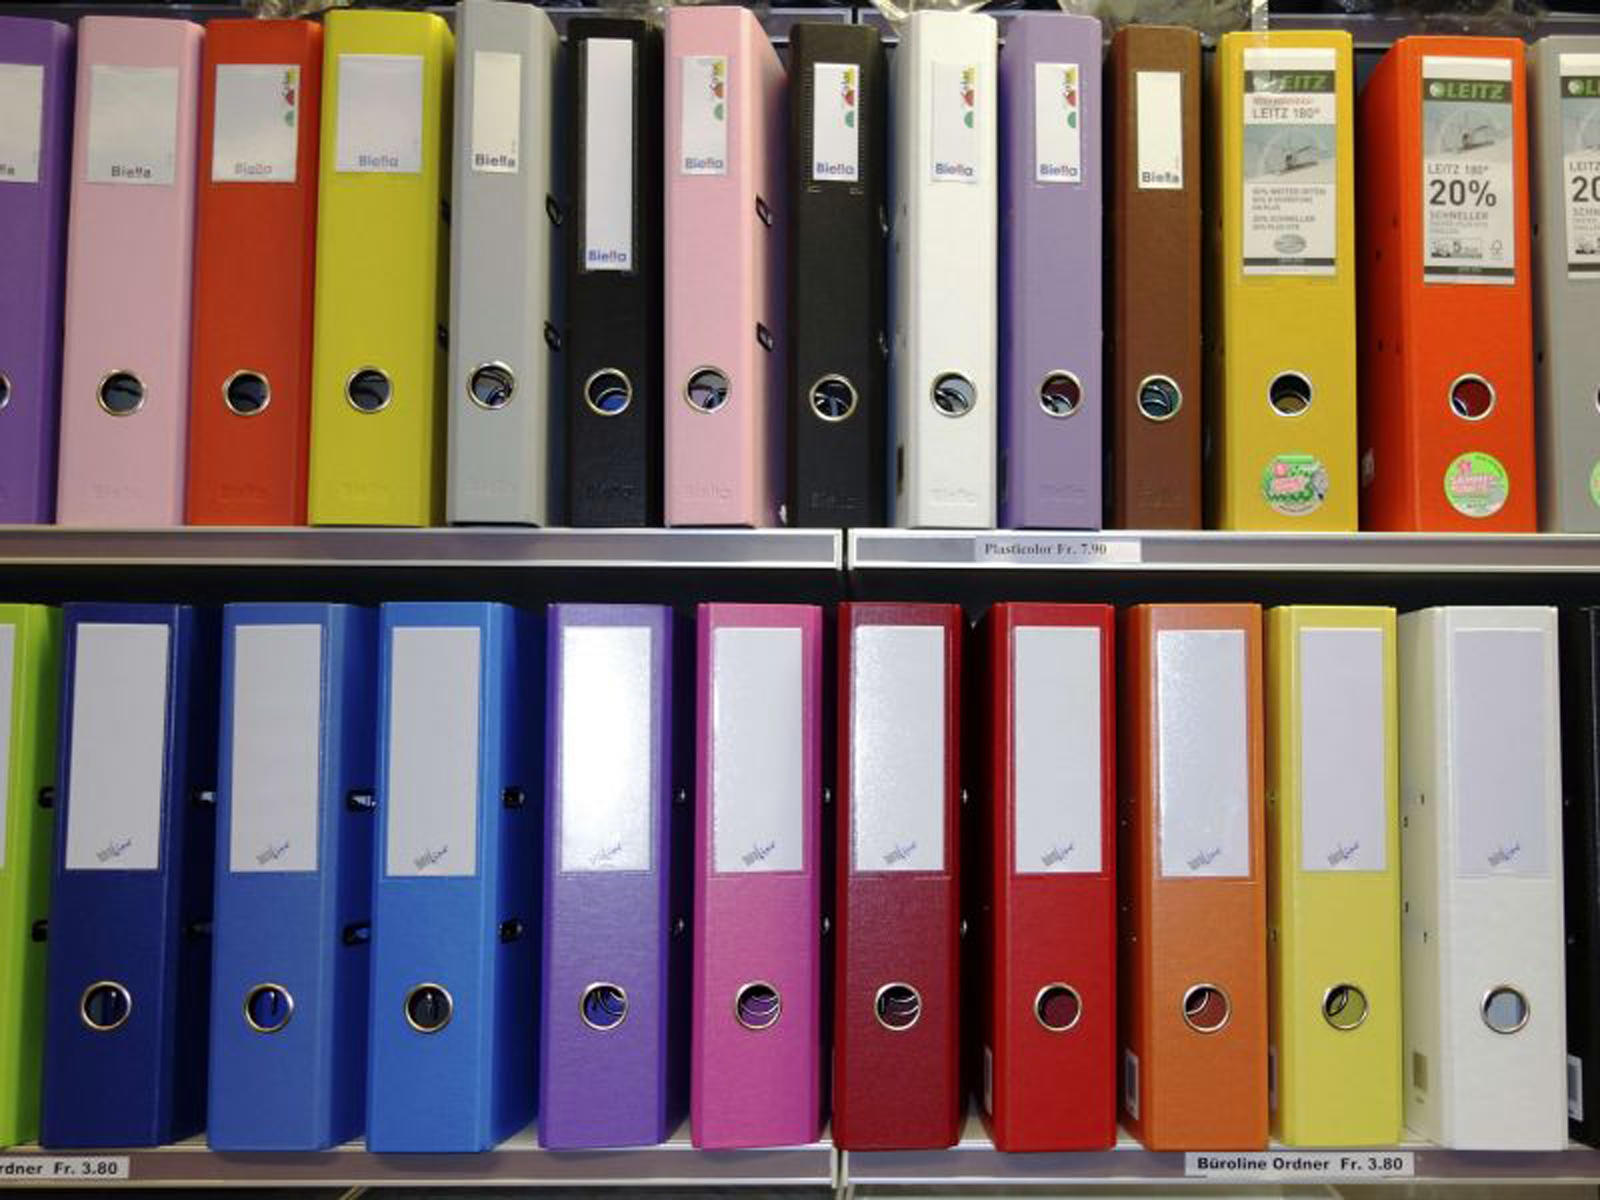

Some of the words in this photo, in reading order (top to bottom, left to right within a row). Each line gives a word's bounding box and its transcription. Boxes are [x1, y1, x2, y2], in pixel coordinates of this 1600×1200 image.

[1447, 82, 1504, 100] LEITZ
[1253, 107, 1289, 119] LEITZ
[1428, 163, 1459, 175] LEITZ
[1429, 178, 1497, 208] 20%
[984, 542, 1052, 556] Plasticolor
[54, 1161, 76, 1175] Fr.
[82, 1161, 118, 1175] 3.80
[1197, 1156, 1267, 1171] Büroline
[1273, 1156, 1330, 1171] Ordner
[1340, 1156, 1363, 1171] Fr.
[1368, 1156, 1404, 1171] 3.80
